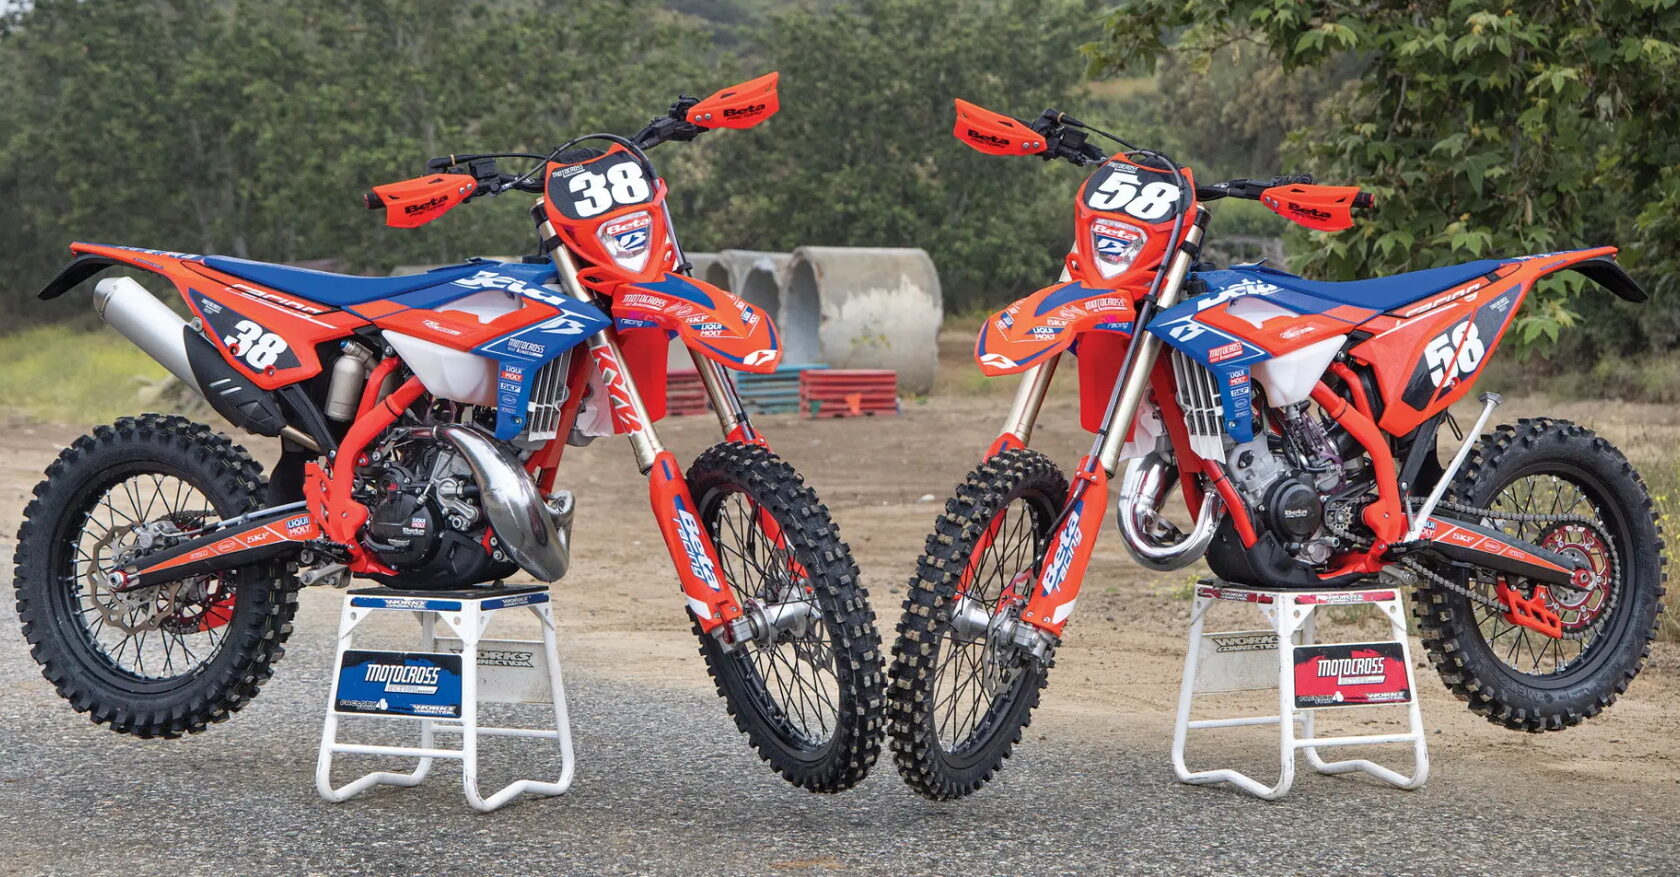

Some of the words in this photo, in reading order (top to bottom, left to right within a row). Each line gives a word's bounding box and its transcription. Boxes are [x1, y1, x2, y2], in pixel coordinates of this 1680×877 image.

[723, 104, 766, 117] Beta
[967, 128, 1010, 145] Beta
[569, 161, 650, 217] 38
[1088, 171, 1181, 219] 58
[404, 195, 448, 214] Beta
[1288, 202, 1332, 218] Beta
[606, 218, 651, 235] Beta
[1093, 225, 1140, 240] Beta
[623, 294, 668, 308] MOTOCROSS
[620, 318, 644, 327] racing
[701, 323, 722, 331] LIQUI
[1032, 326, 1055, 334] LIQUI
[700, 330, 722, 338] MOLY
[223, 319, 288, 370] 38
[508, 337, 546, 354] MOTOCROSS
[1423, 320, 1485, 388] 58
[286, 516, 310, 529] LIQUI
[288, 525, 311, 536] MOLY
[246, 532, 270, 544] SKF
[672, 517, 704, 579] racing
[678, 509, 720, 590] Beta
[1041, 510, 1080, 594] Beta
[1055, 526, 1083, 592] racing
[1216, 644, 1281, 653] CONNECTIO
[365, 663, 441, 690] MOTOCROSS
[1317, 656, 1385, 684] MOTOCROSS
